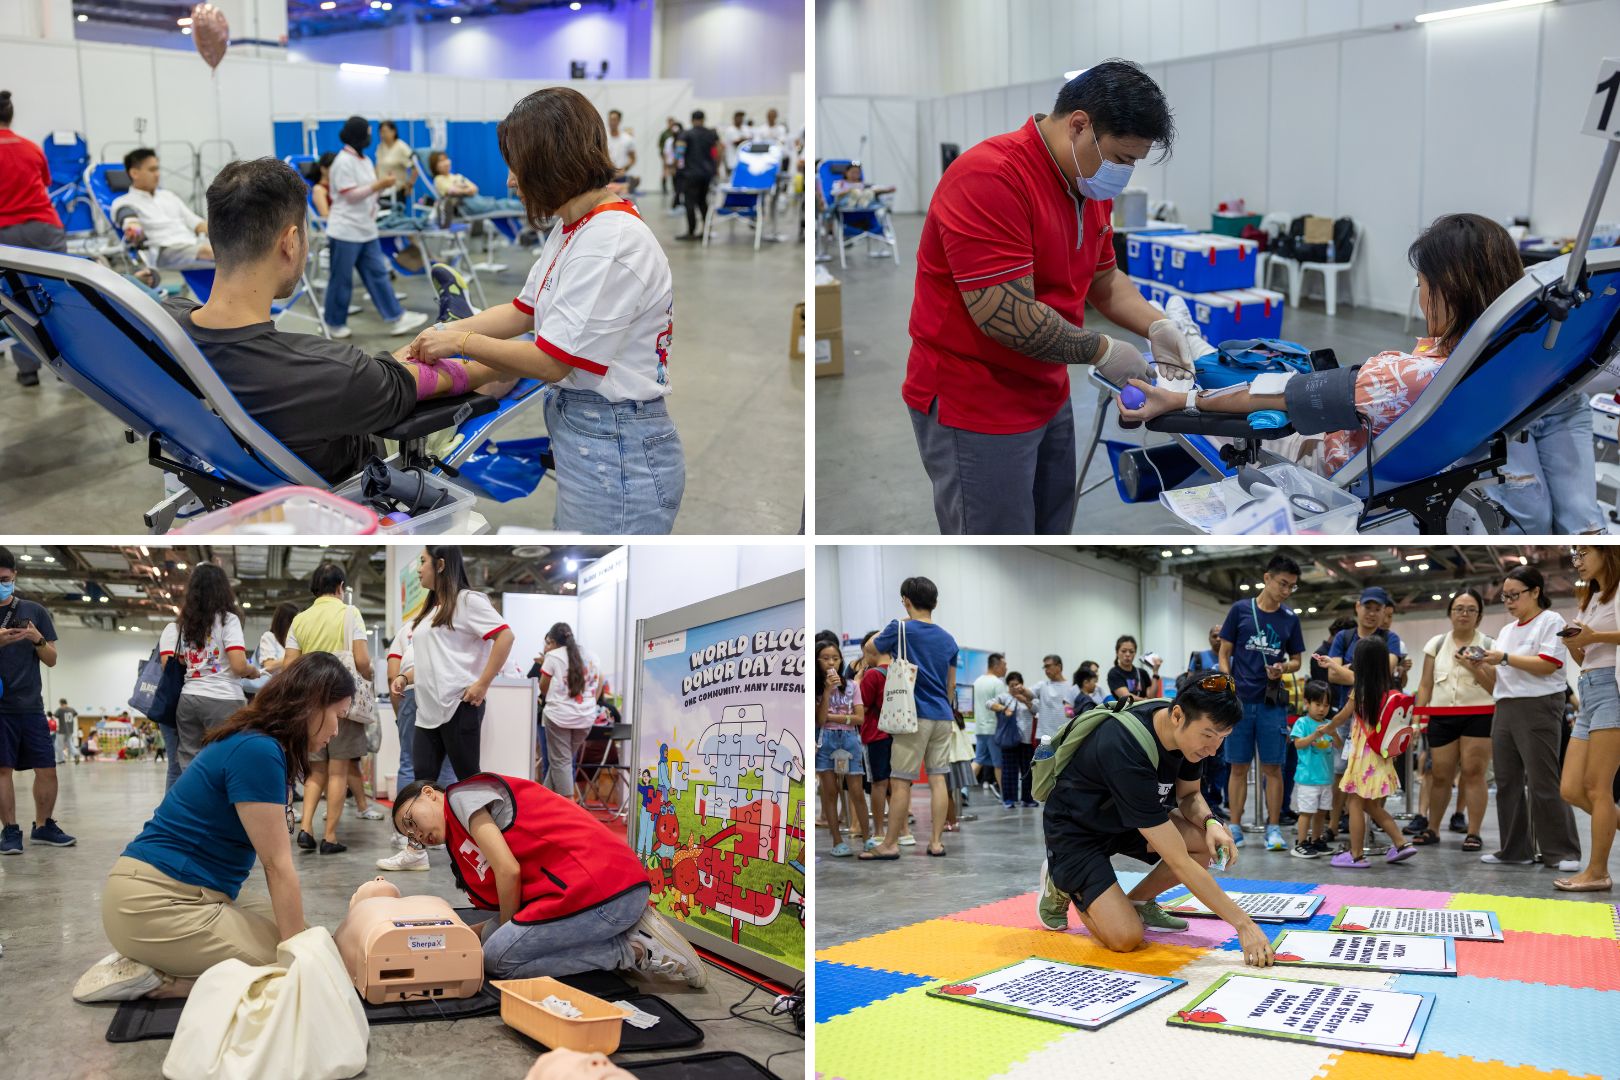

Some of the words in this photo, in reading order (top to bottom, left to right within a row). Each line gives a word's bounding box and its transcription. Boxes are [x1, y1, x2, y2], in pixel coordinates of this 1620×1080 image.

[689, 634, 749, 671] WORLD
[682, 660, 736, 696] DONOR
[738, 653, 779, 679] DAY
[684, 694, 697, 708] ONE
[744, 682, 768, 693] MANY
[1247, 988, 1287, 1018] DONATION.
[1273, 995, 1300, 1014] BLOOD
[1292, 987, 1325, 1015] RECEIVES
[1320, 987, 1344, 1006] WHICH
[1340, 994, 1358, 1007] CAN
[1283, 1016, 1301, 1027] MY
[1299, 1007, 1330, 1033] PATIENT
[1321, 1007, 1350, 1034] SPECIFY
[1349, 1002, 1374, 1024] MYTH:
